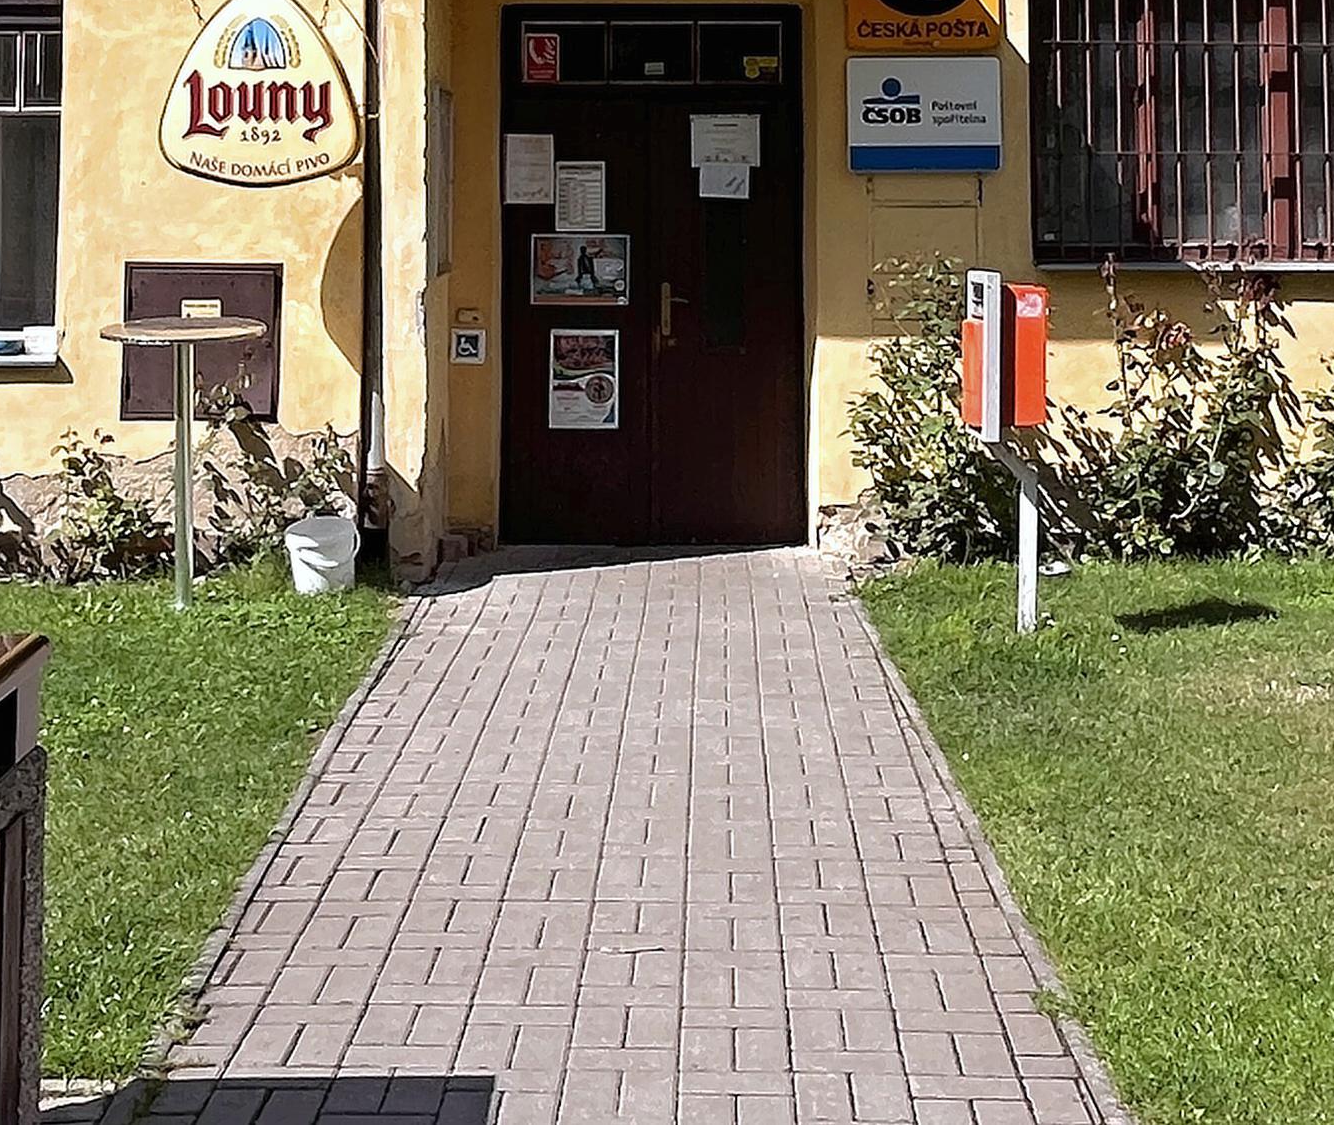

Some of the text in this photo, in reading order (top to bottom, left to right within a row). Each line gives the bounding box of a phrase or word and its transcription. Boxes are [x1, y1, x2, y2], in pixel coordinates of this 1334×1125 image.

[856, 18, 990, 38] ČESKÁ POŠTA
[181, 69, 333, 143] Louny
[862, 105, 922, 125] ČSOB
[239, 127, 282, 143] 1892
[190, 152, 330, 177] NAŠE DOMÁCÍ PIVO
